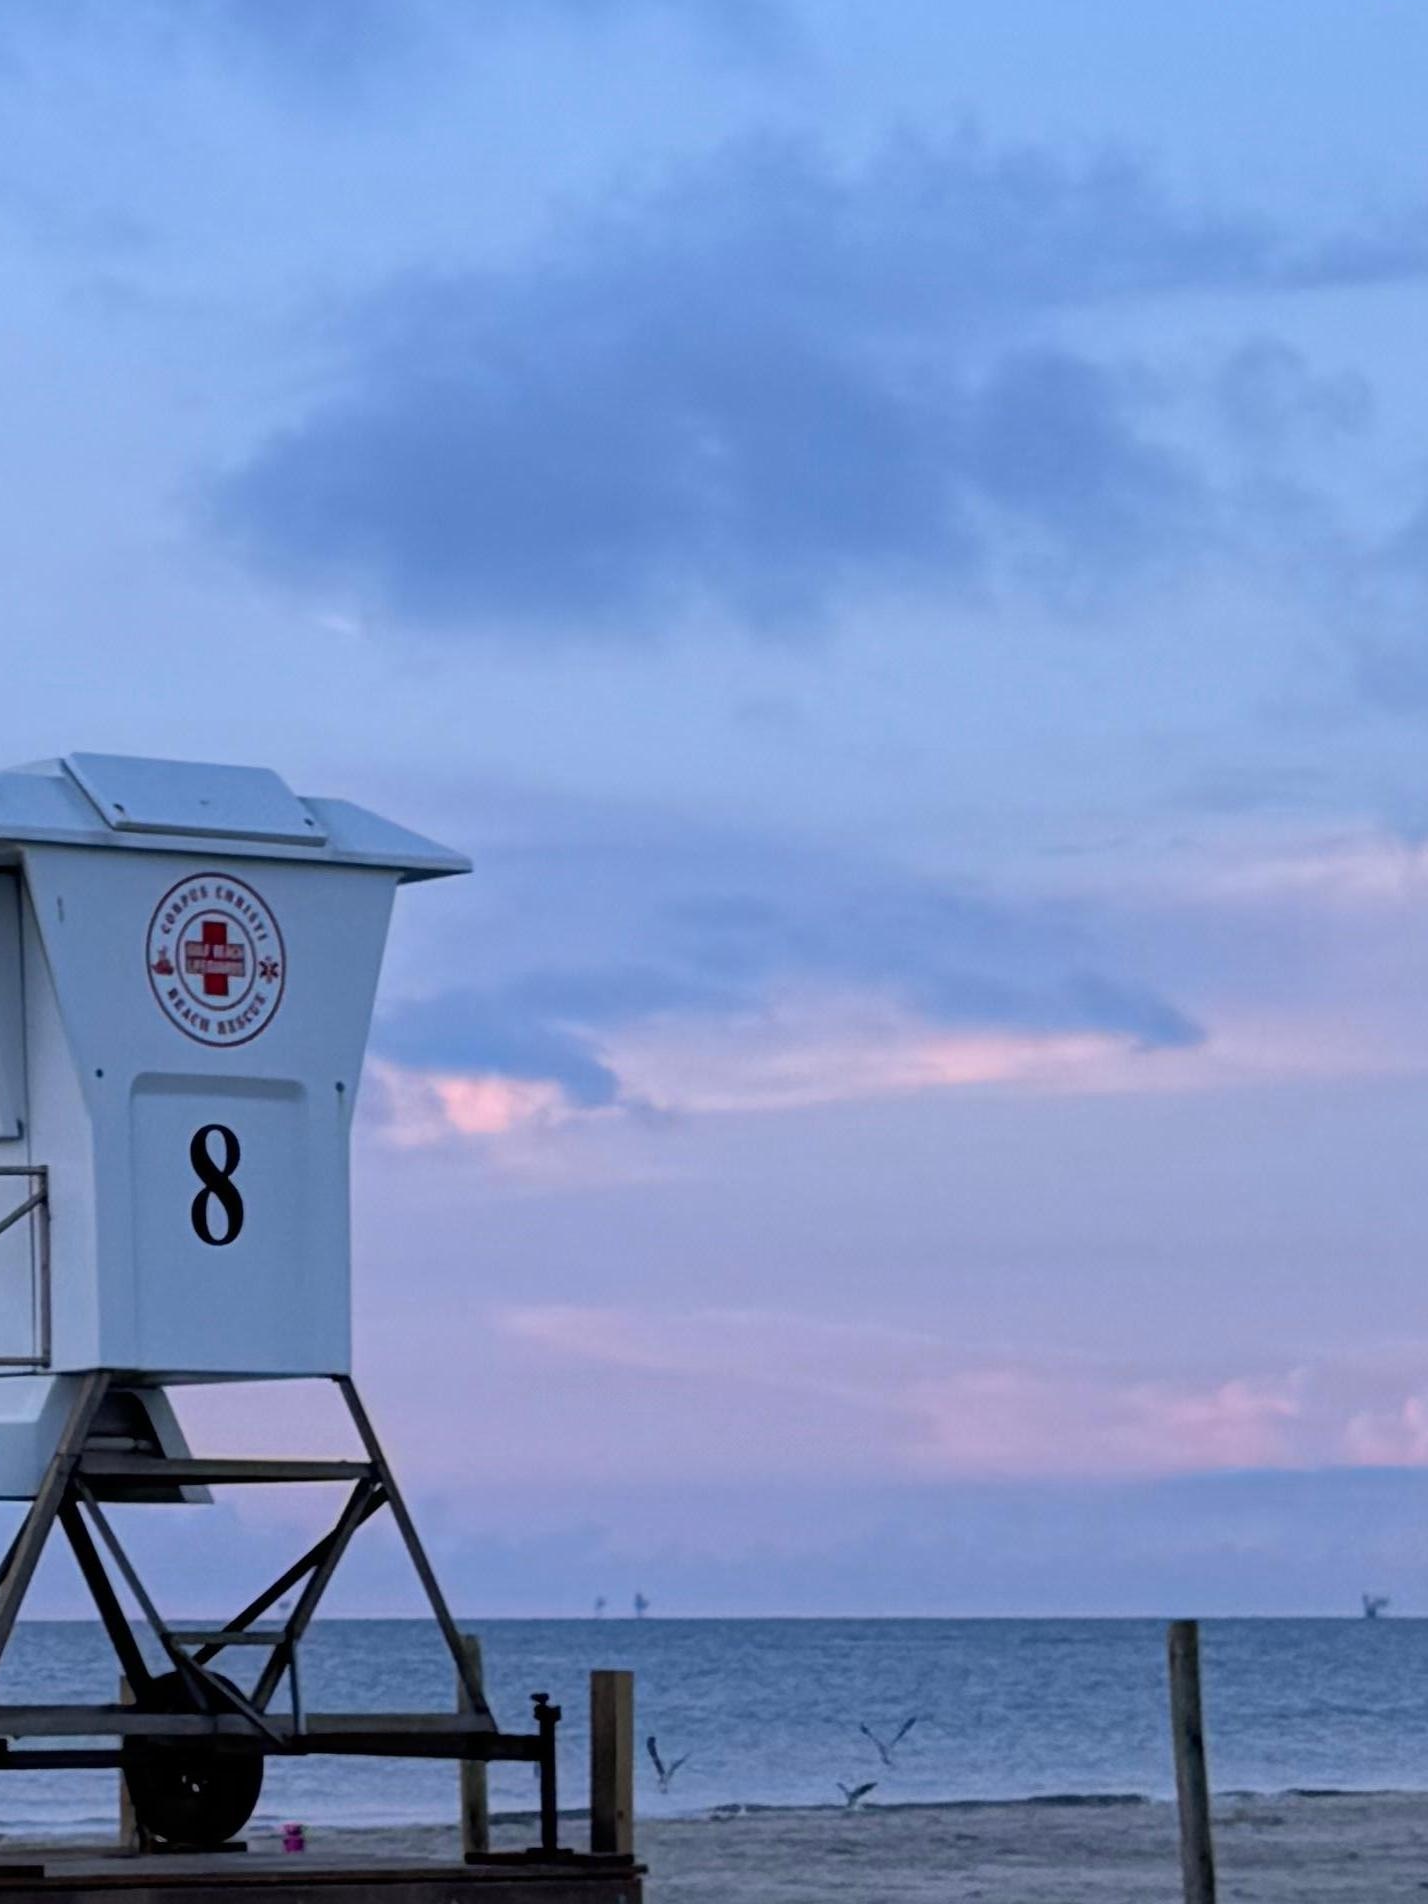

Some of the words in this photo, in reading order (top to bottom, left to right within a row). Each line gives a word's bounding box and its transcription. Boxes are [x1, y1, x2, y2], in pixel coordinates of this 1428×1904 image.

[161, 885, 208, 934] CORPUS
[215, 885, 268, 941] CHRISTI
[168, 987, 211, 1032] BEACH
[217, 993, 266, 1035] RESCUE
[190, 1124, 244, 1246] 8
